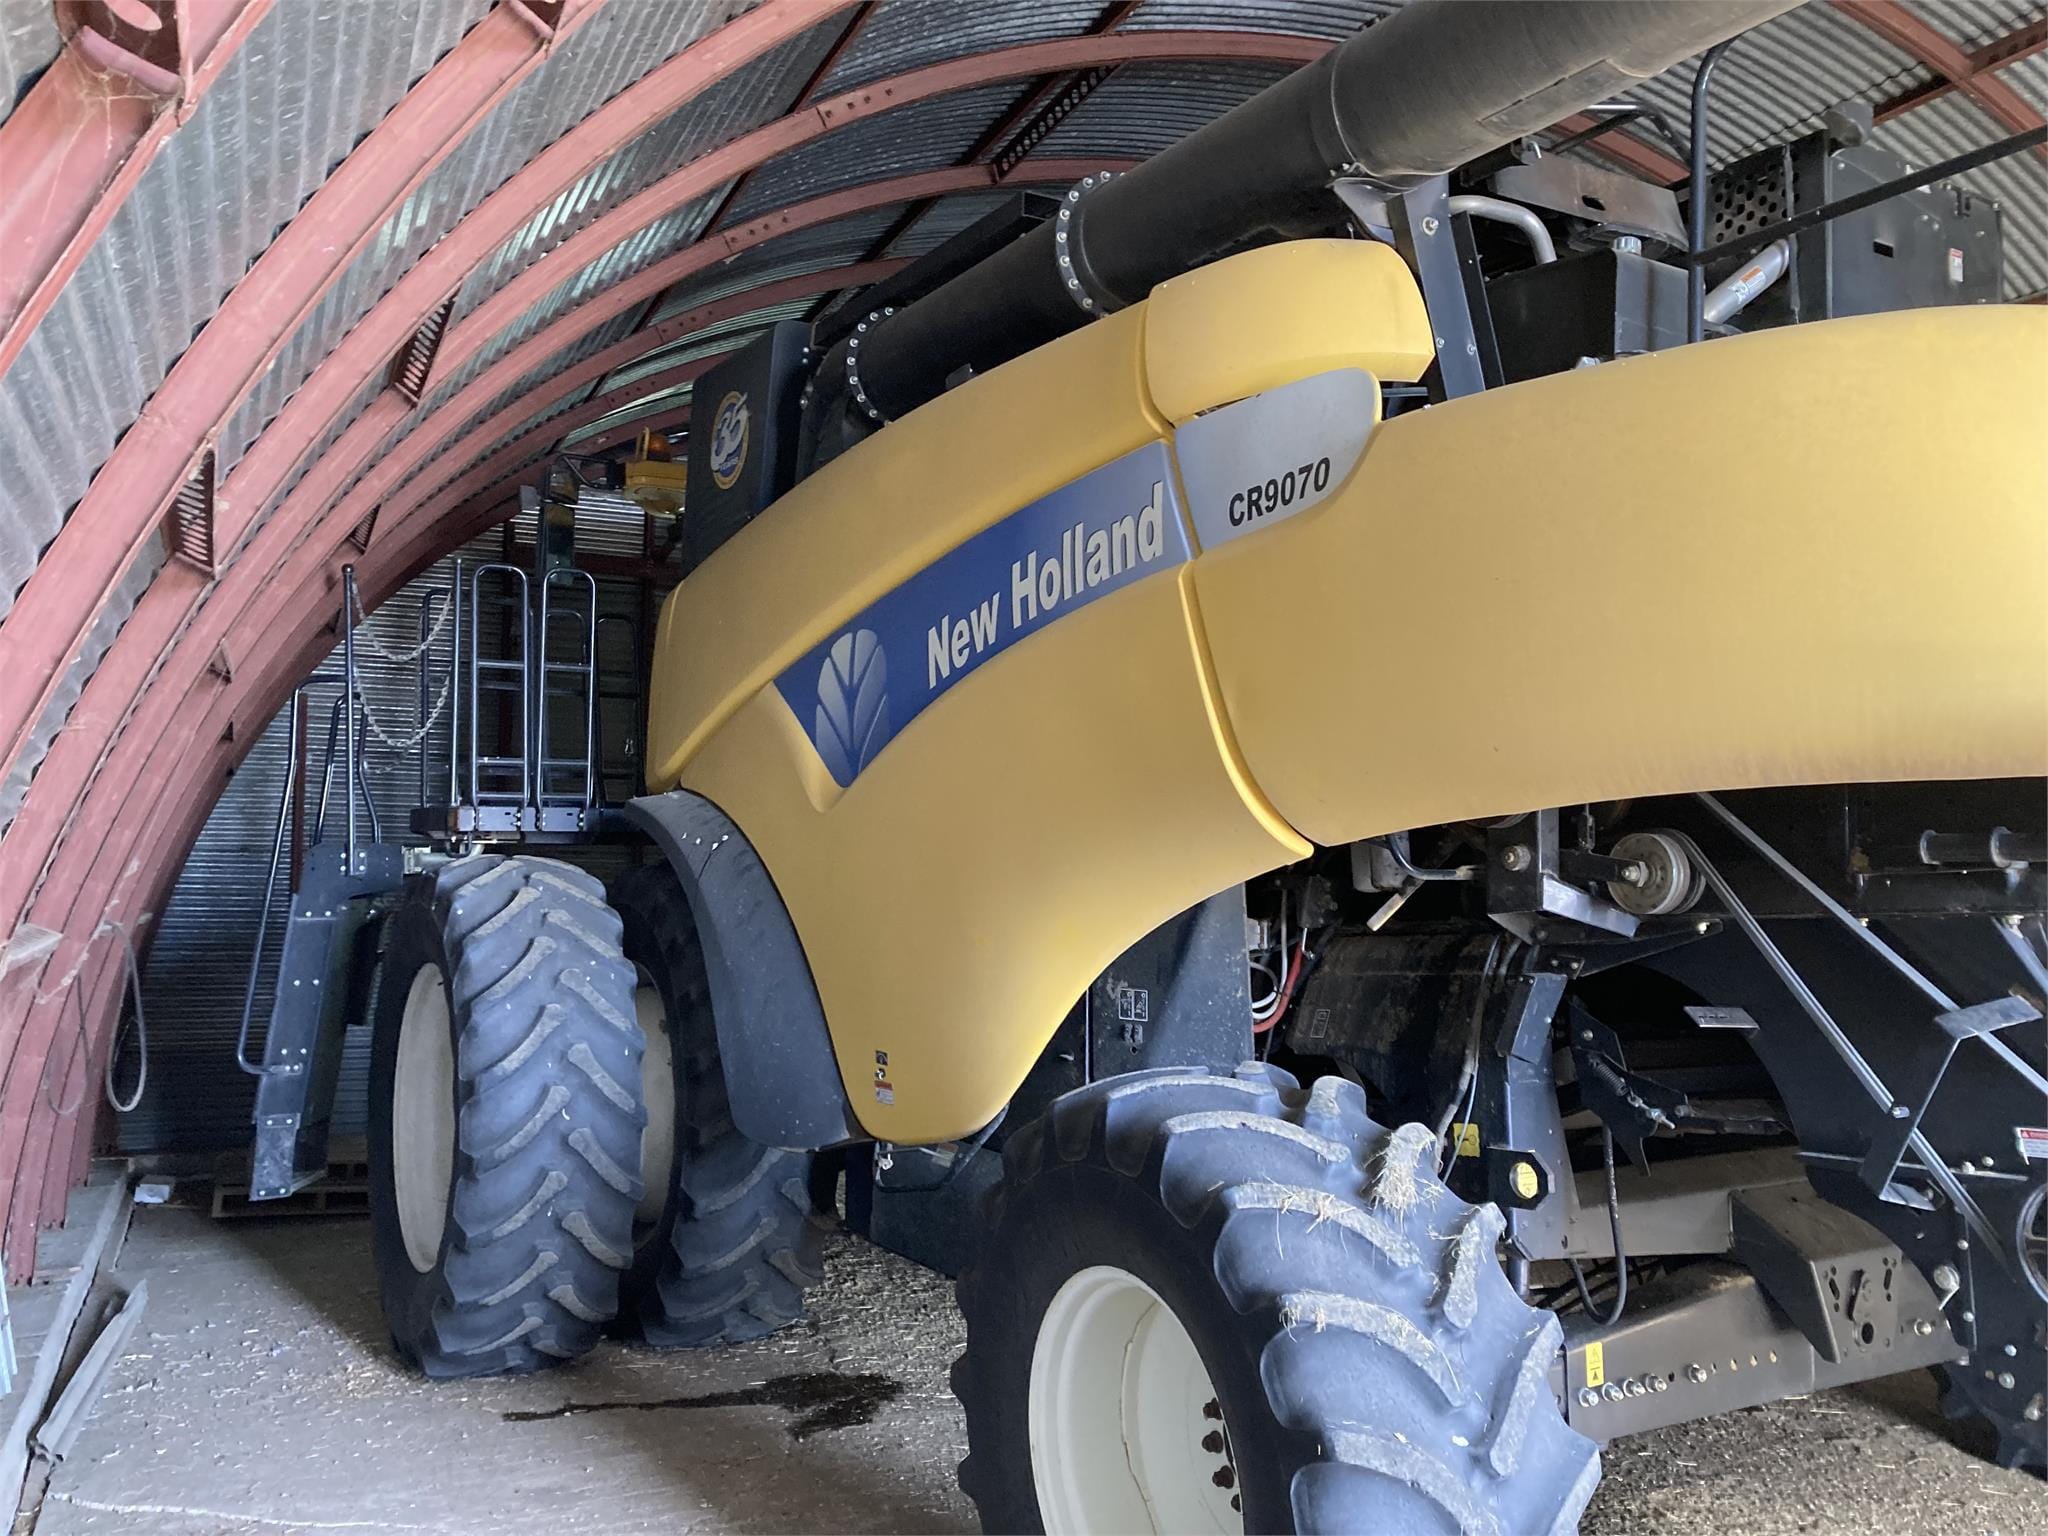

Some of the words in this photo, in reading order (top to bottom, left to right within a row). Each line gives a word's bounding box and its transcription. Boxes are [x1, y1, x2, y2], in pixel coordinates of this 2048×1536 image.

[1229, 457, 1330, 527] CR9070
[928, 591, 1000, 689] New
[1011, 480, 1164, 629] Holland
